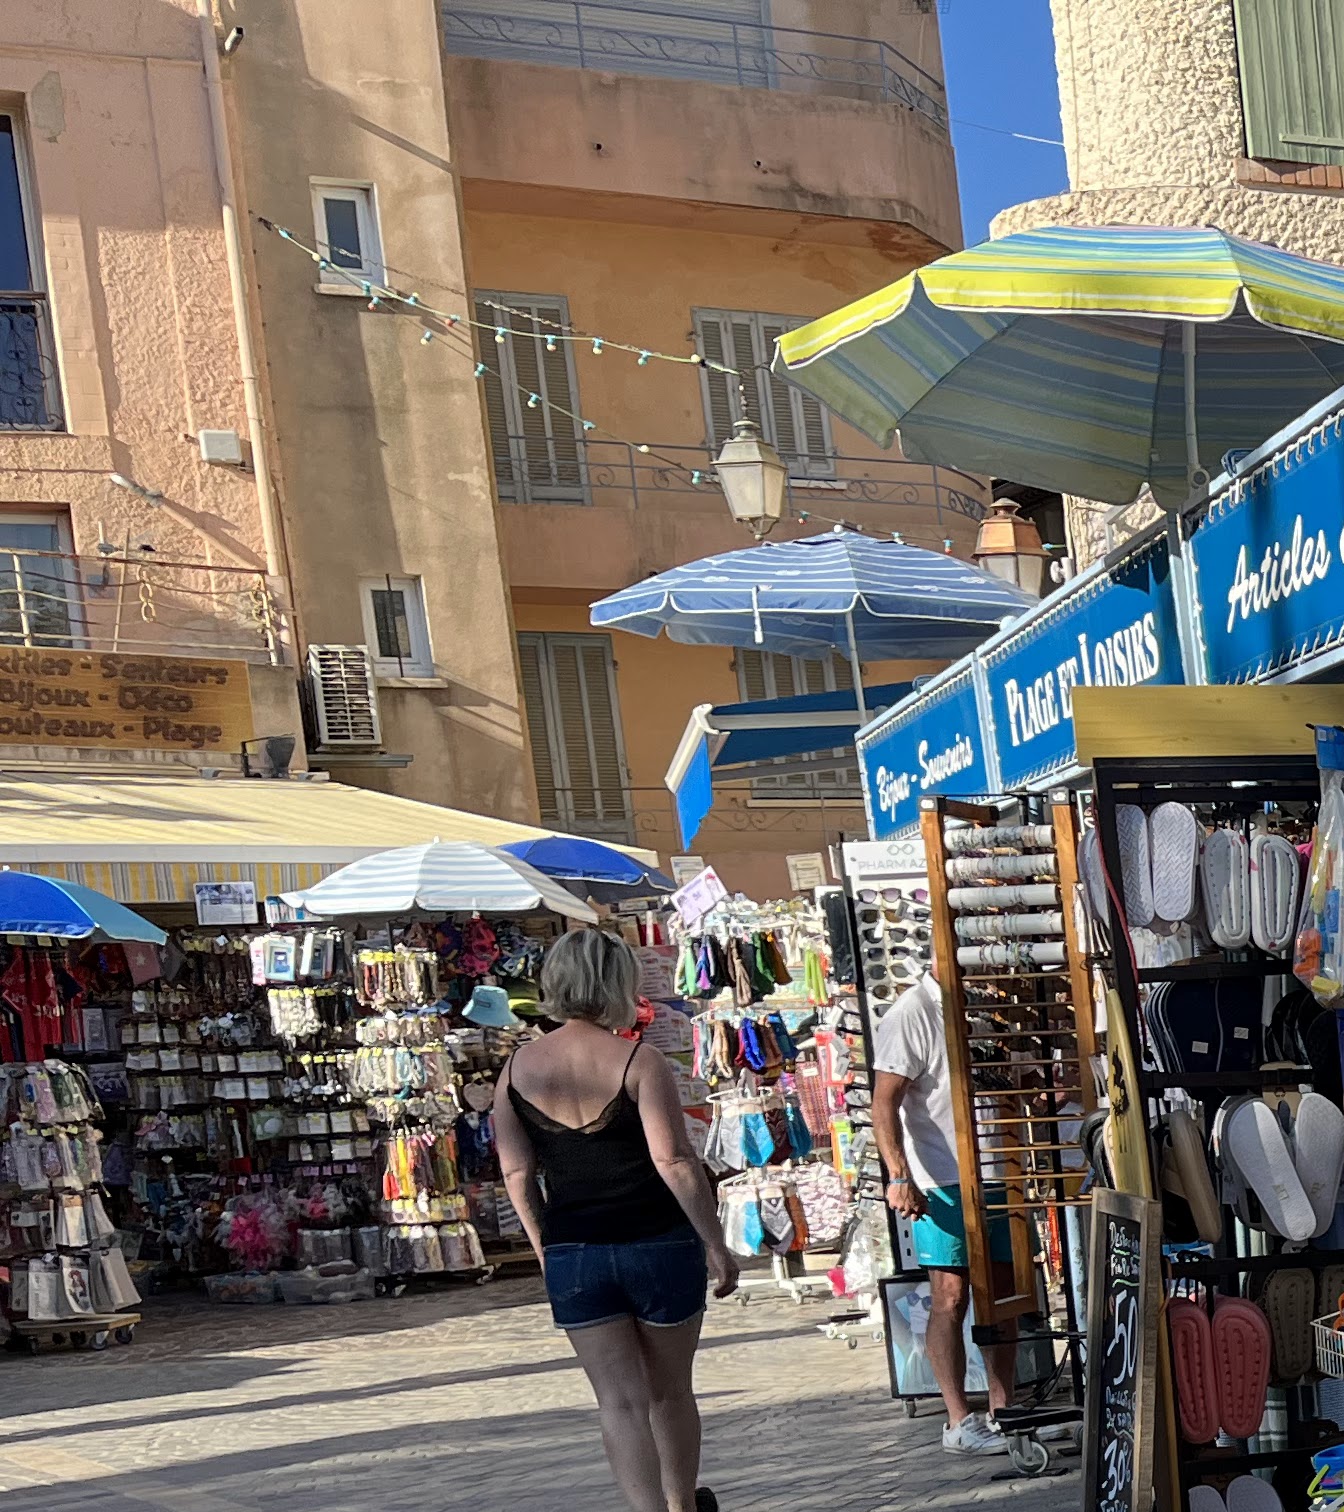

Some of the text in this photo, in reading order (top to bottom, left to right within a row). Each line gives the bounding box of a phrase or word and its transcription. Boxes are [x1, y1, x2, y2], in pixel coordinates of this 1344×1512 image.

[1226, 513, 1331, 634] Articles
[143, 714, 222, 748] Plage
[1004, 678, 1060, 747] PLAGE
[1078, 612, 1160, 687] LOISIRS
